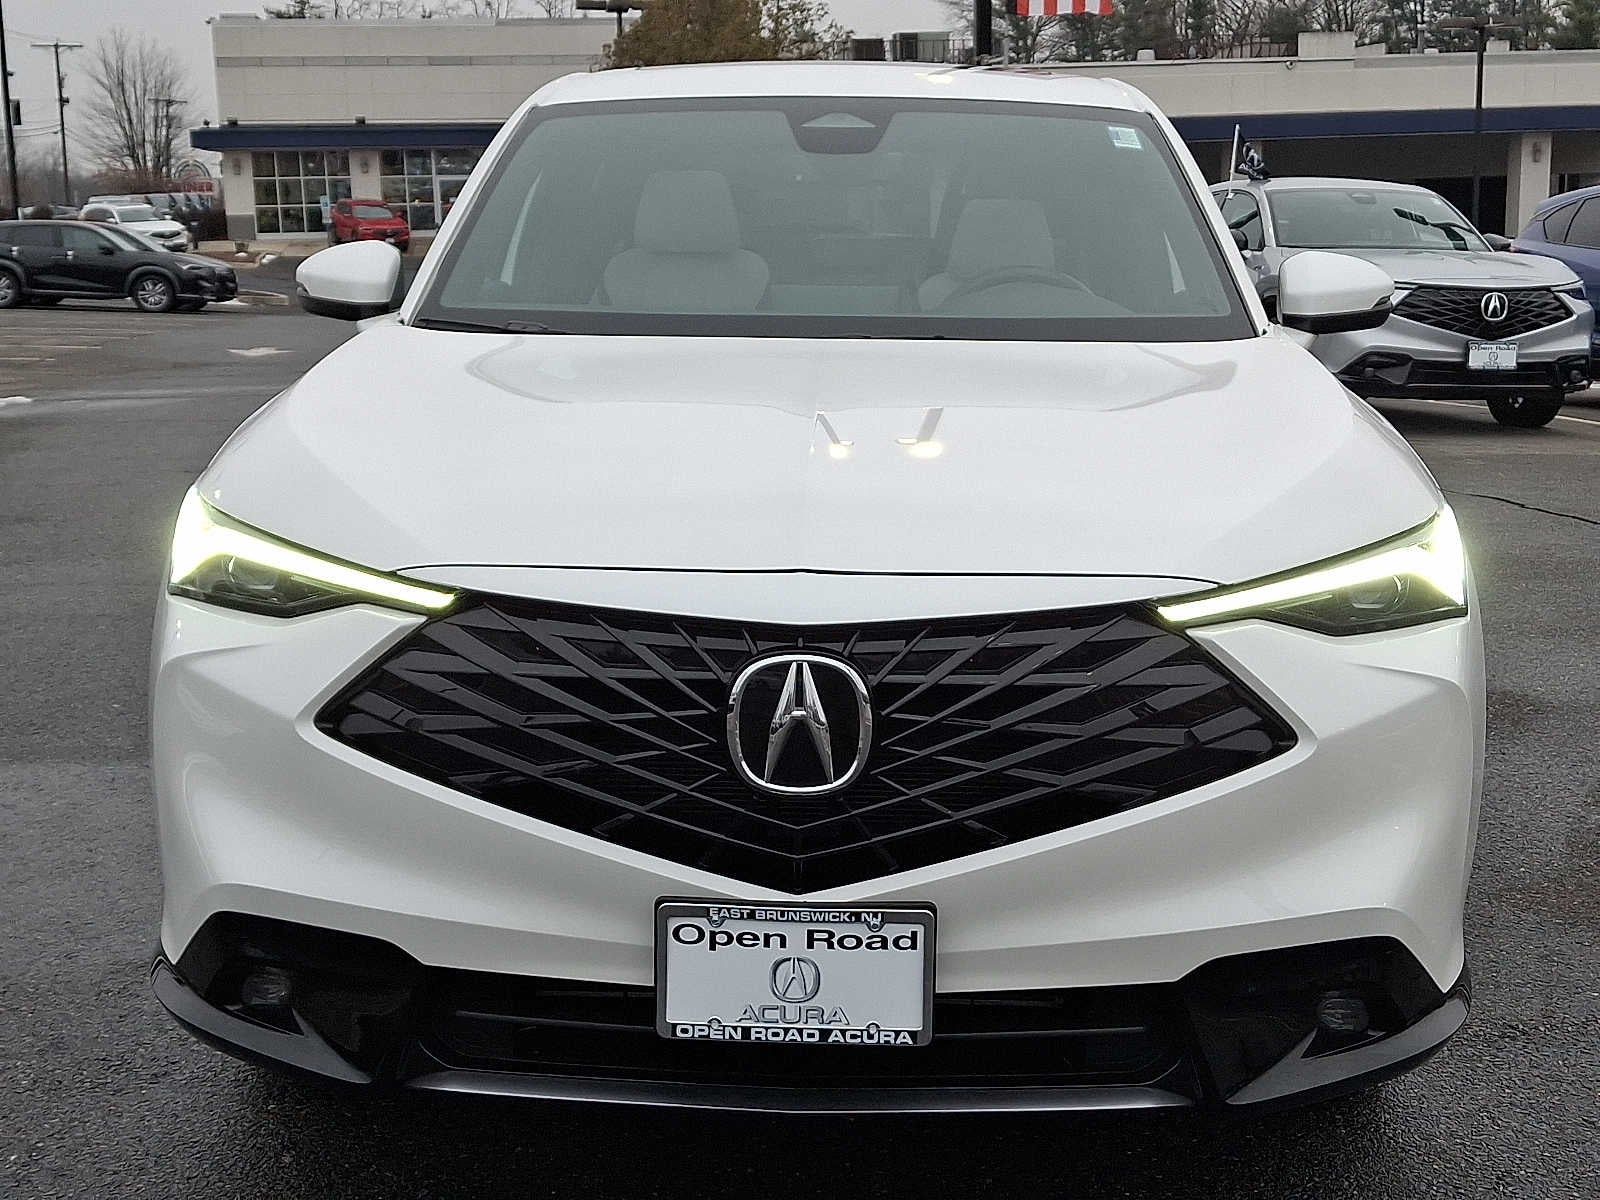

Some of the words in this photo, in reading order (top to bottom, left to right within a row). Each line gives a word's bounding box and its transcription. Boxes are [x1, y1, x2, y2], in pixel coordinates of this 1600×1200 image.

[709, 907, 751, 919] EAST
[755, 910, 855, 922] BRUNSWICK,
[861, 912, 882, 923] NJ
[671, 923, 787, 951] Open
[806, 929, 918, 951] Road
[735, 1003, 850, 1025] ACURA
[676, 1024, 742, 1040] OPEN
[750, 1027, 820, 1042] ROAD
[827, 1030, 914, 1045] ACURA
